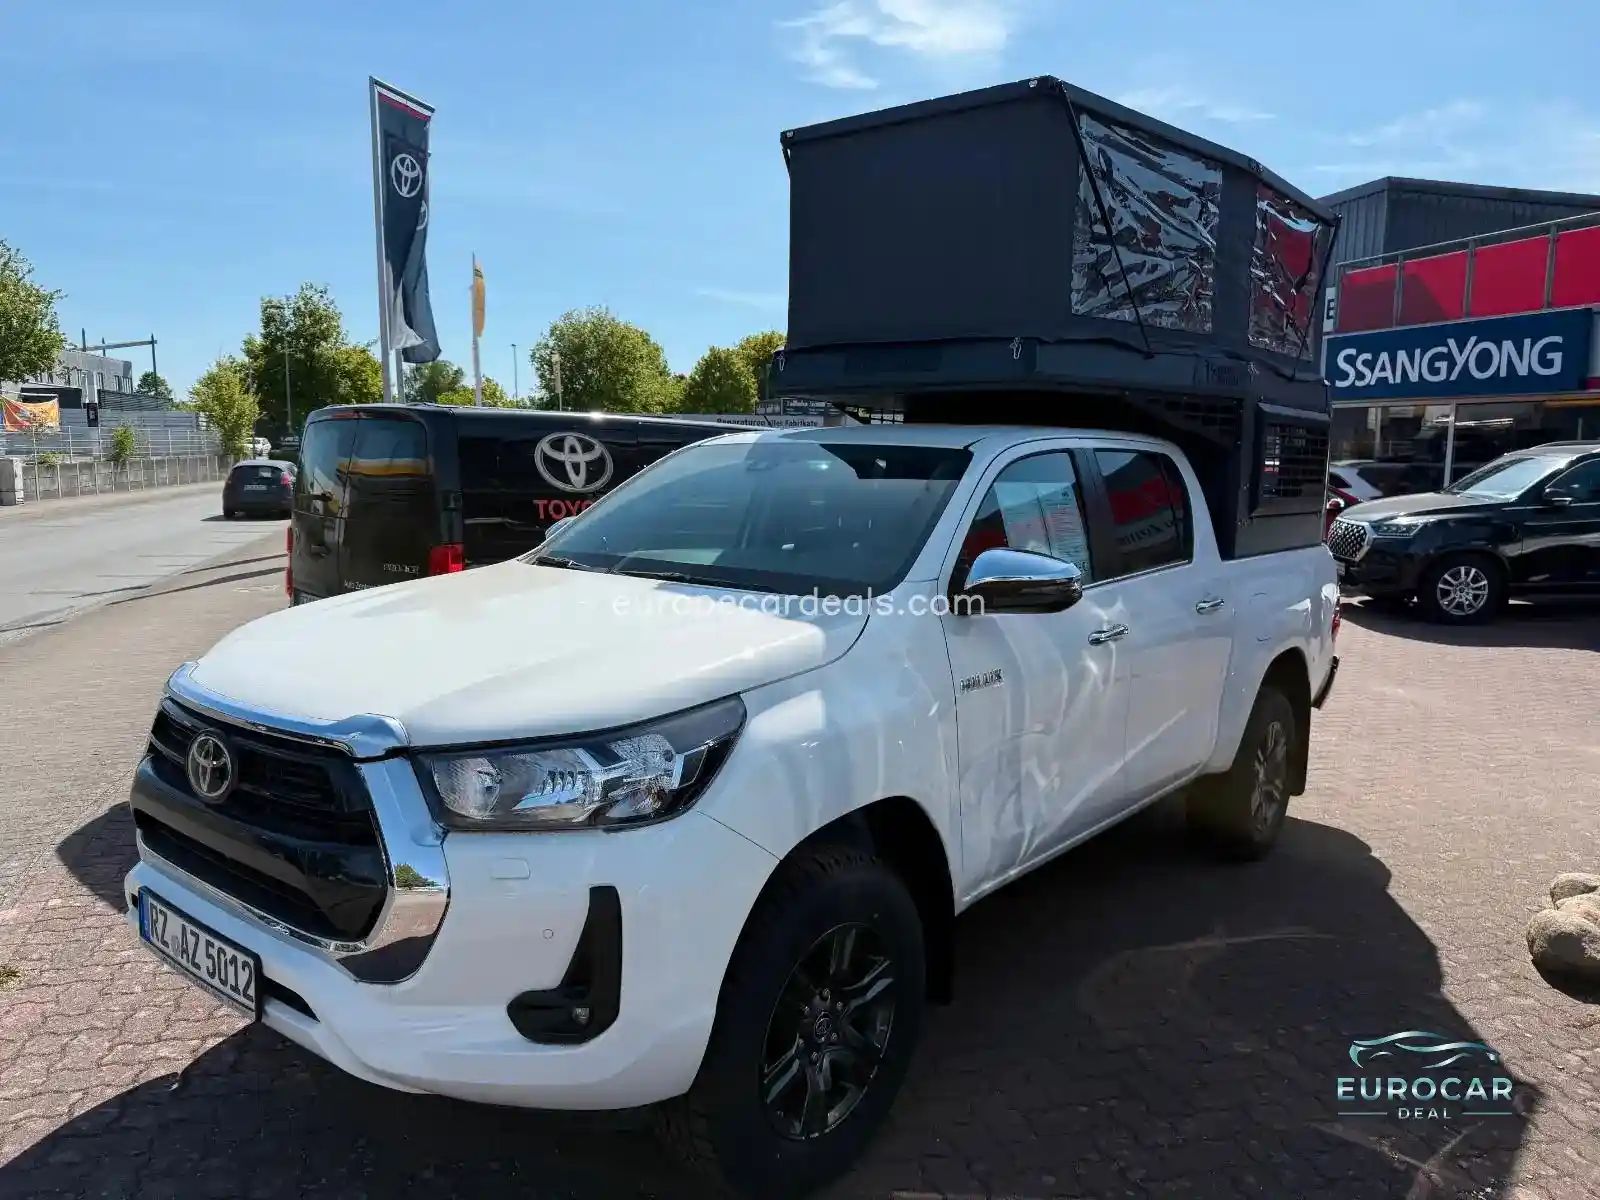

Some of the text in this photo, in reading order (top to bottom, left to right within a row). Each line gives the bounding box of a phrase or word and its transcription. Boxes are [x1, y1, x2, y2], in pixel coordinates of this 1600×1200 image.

[1334, 335, 1563, 388] SSANGYONG
[151, 904, 170, 948] RZ
[181, 924, 202, 972] AZ
[205, 939, 254, 1003] 5012
